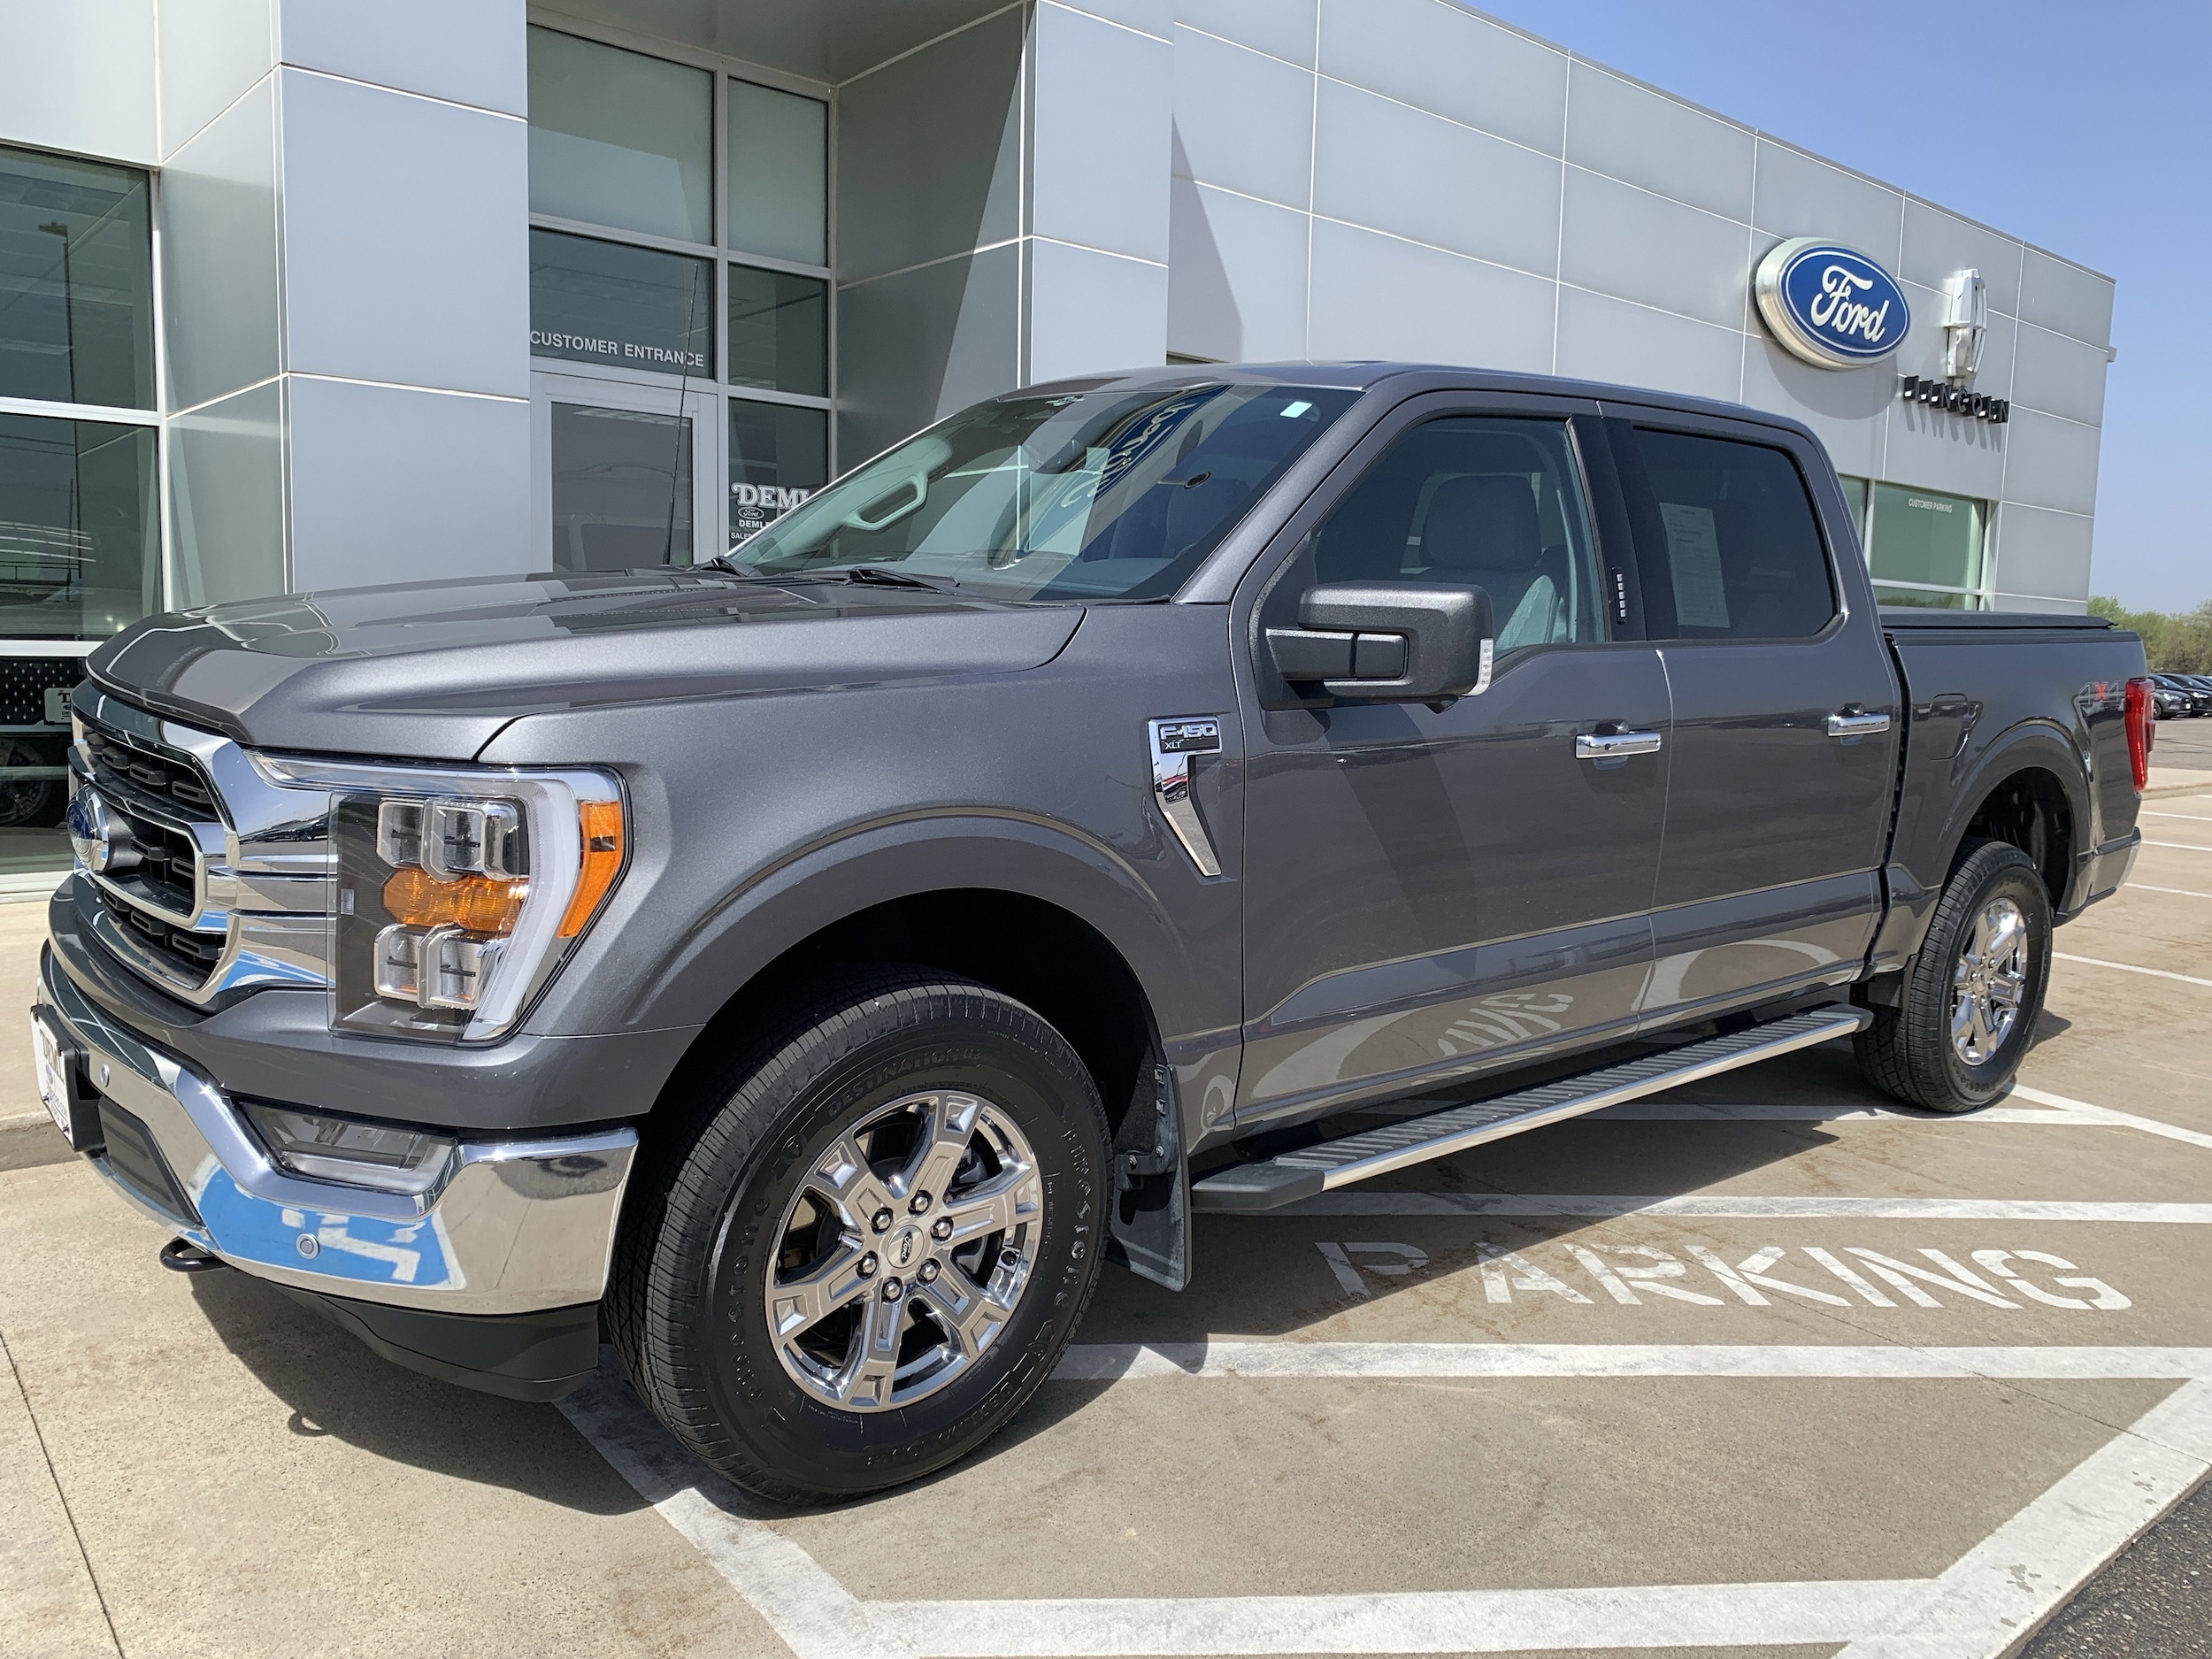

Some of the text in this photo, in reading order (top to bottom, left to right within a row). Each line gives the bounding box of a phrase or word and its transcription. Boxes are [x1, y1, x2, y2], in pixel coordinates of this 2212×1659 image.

[1810, 265, 1890, 342] Ford
[530, 330, 704, 366] CUSTOMER ENTRANCE
[1909, 498, 1932, 510] CUSTOMER
[1160, 723, 1217, 740] F-150
[1164, 741, 1181, 749] XLT
[1315, 1240, 2132, 1310] PARKING
